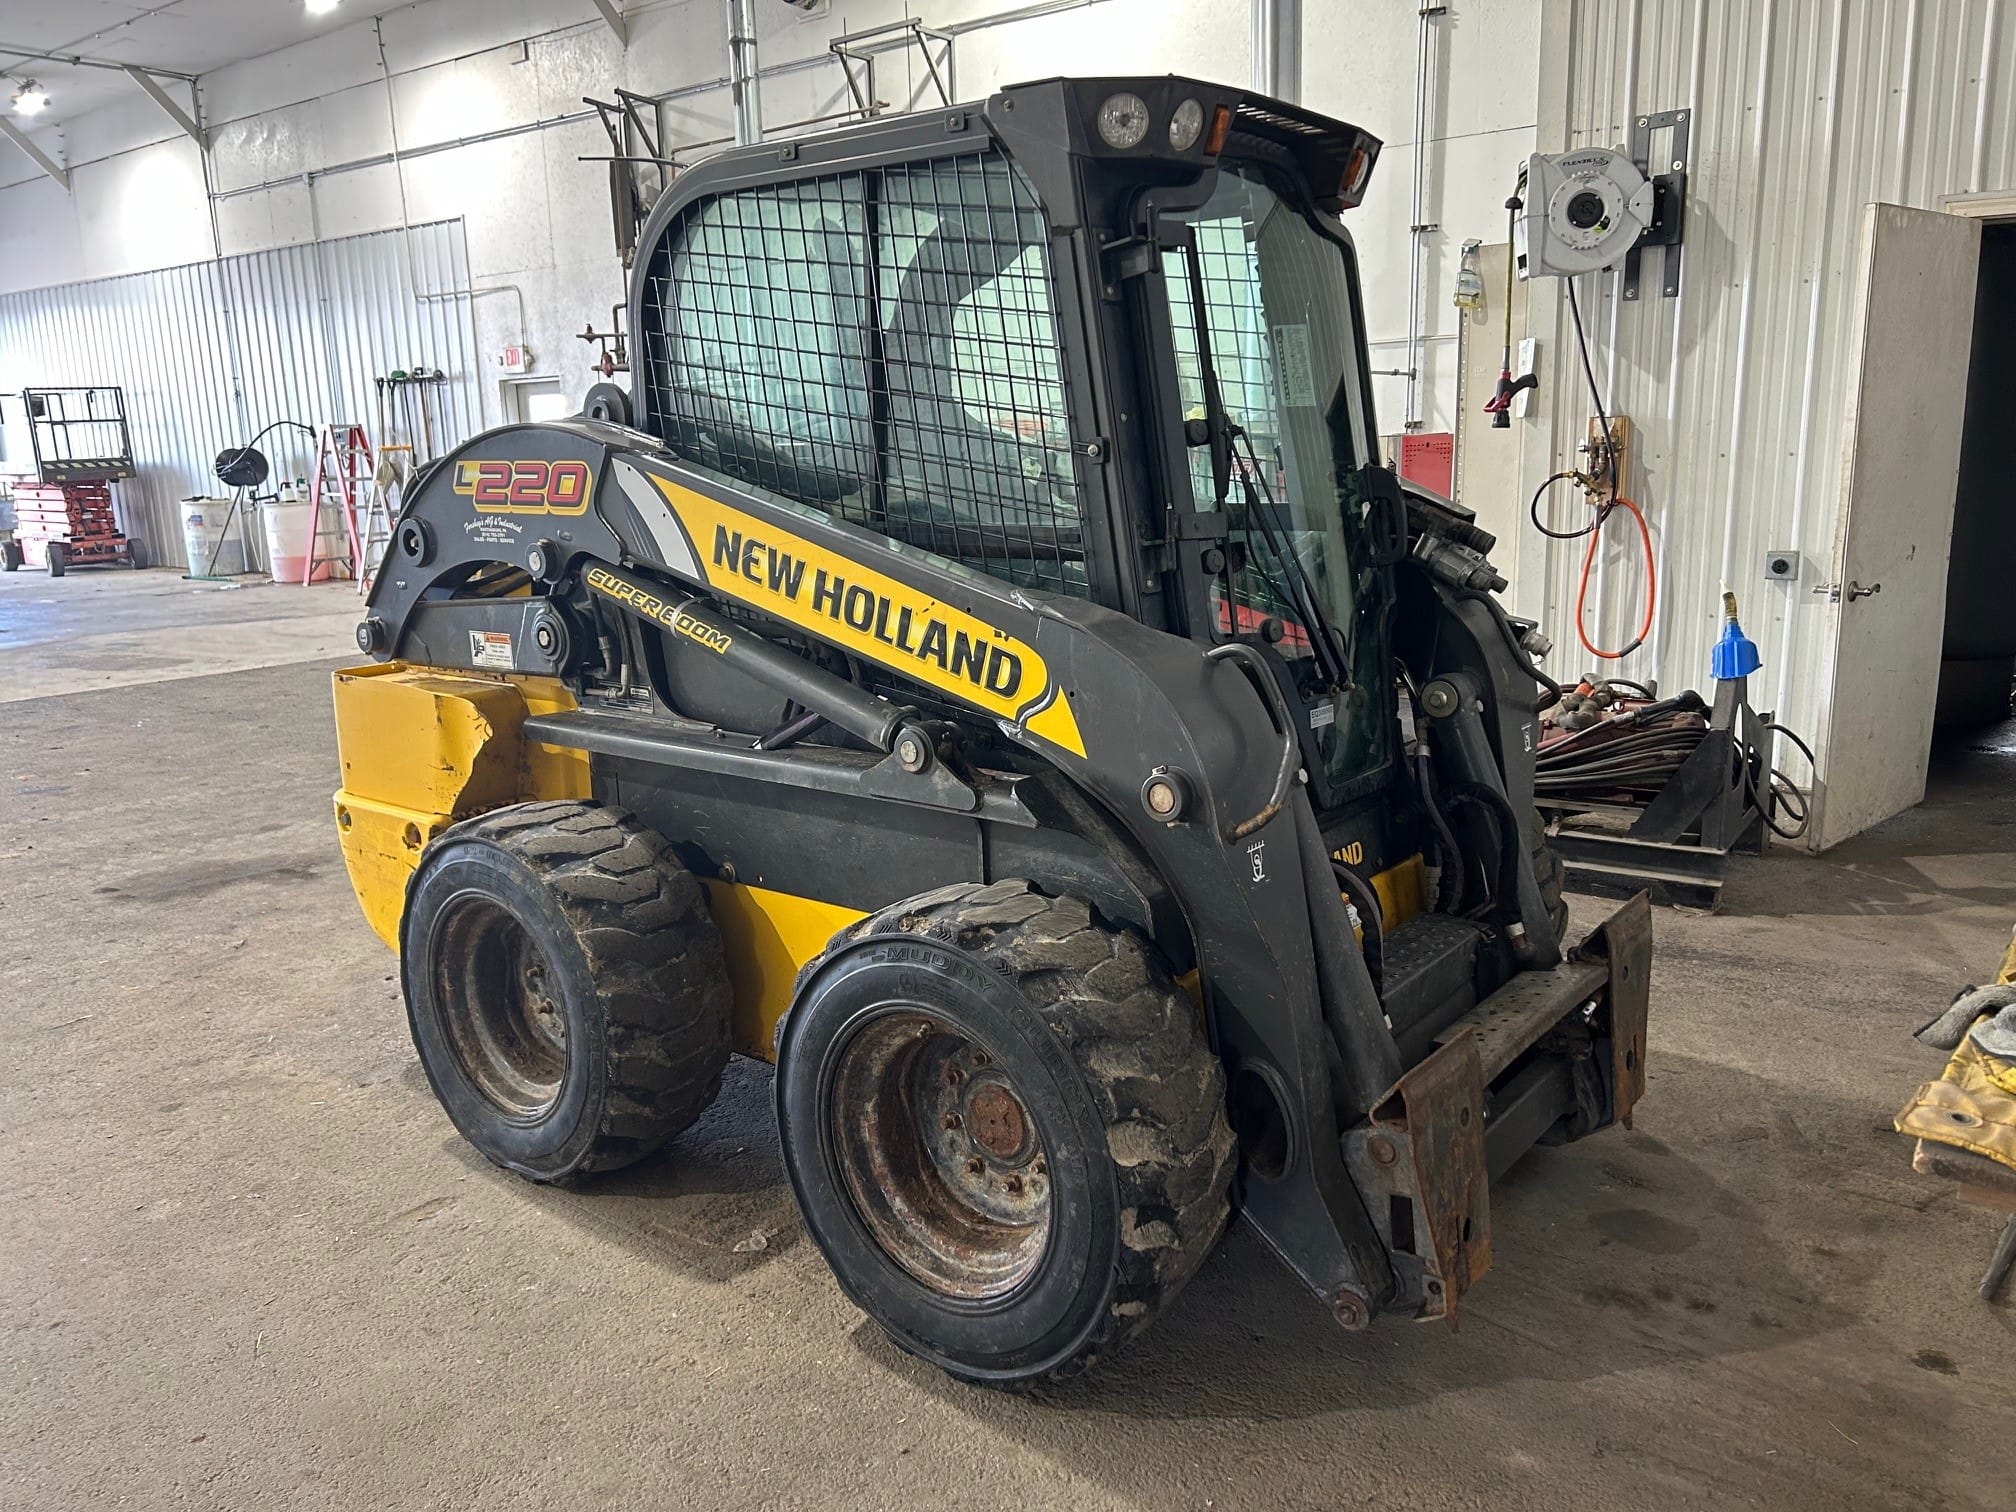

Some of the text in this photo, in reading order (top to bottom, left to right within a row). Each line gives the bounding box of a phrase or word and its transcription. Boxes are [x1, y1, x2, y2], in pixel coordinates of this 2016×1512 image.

[454, 462, 590, 509] L220
[588, 568, 663, 618] SUPER
[713, 524, 1024, 699] NEW HOLLAND
[886, 946, 994, 993] MUDDY
